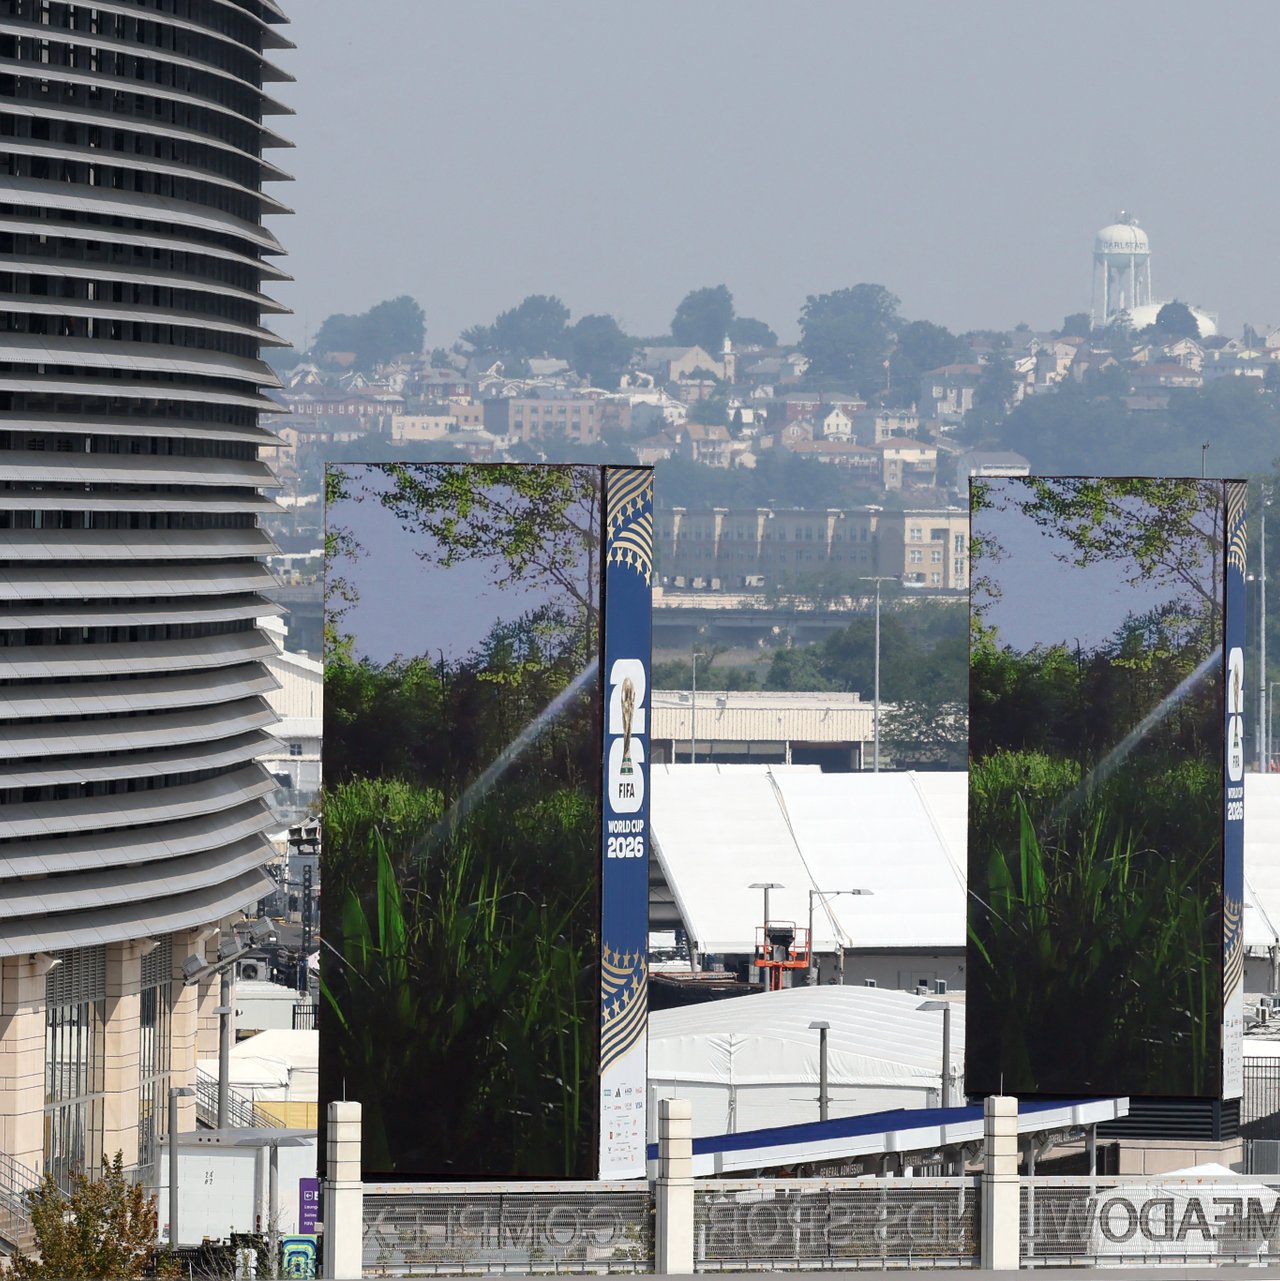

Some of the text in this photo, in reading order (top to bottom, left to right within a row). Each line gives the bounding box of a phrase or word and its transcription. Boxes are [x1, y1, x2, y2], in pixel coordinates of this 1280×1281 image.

[619, 783, 635, 798] FIFA
[1227, 801, 1244, 821] 2026
[607, 819, 645, 833] WORLD CUP
[607, 836, 644, 858] 2026
[820, 1162, 864, 1178] GENERAL ADMISSION
